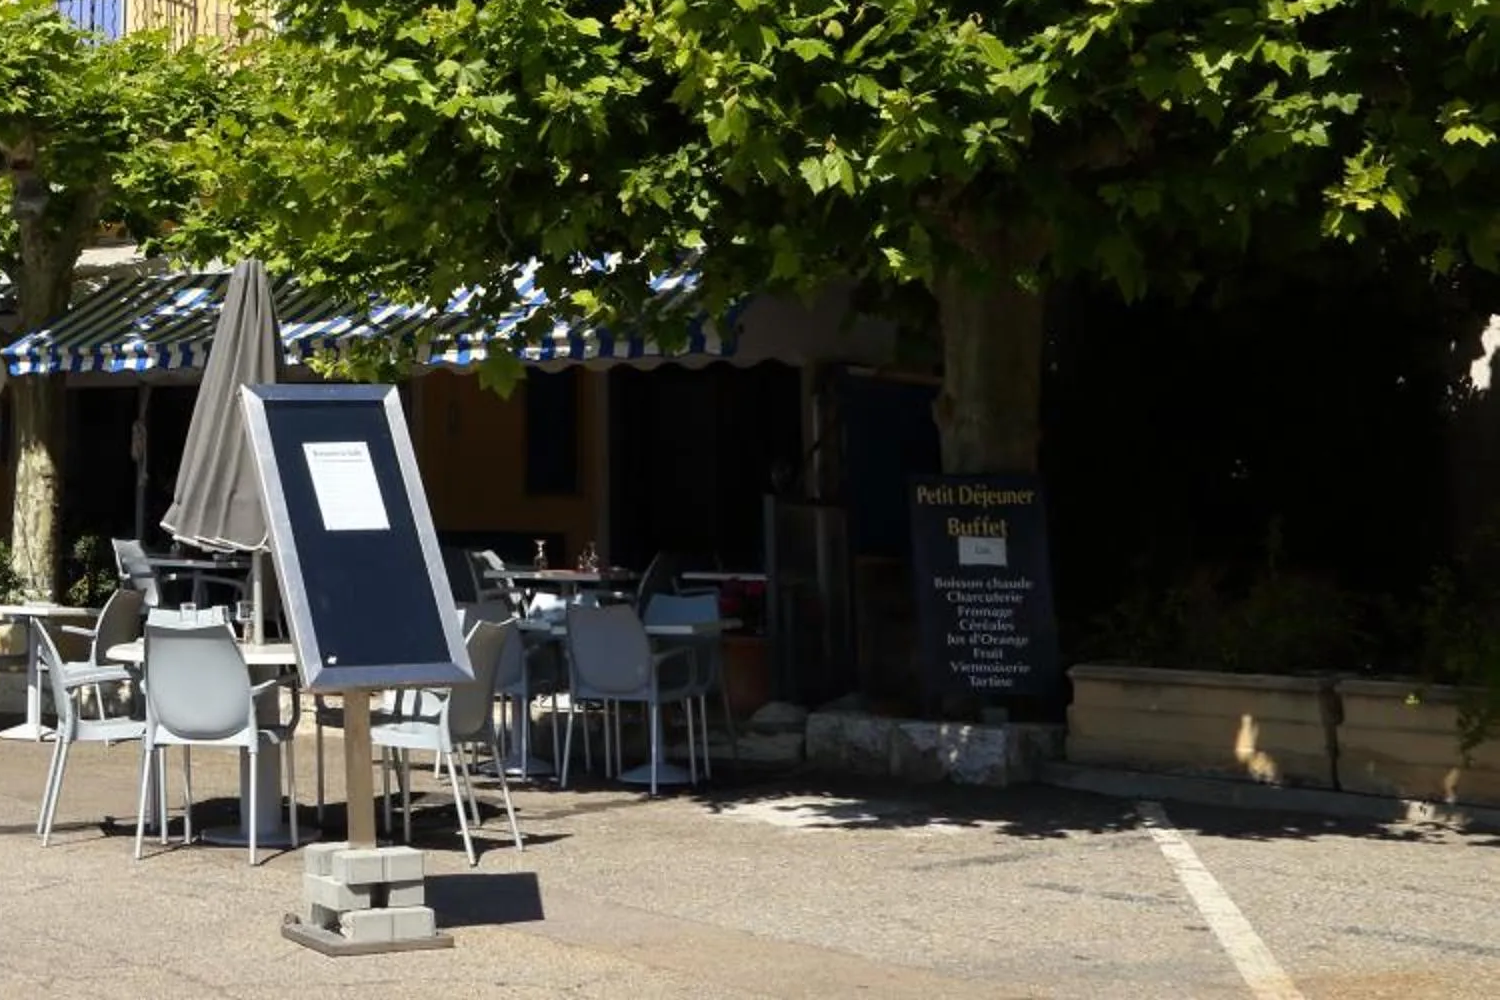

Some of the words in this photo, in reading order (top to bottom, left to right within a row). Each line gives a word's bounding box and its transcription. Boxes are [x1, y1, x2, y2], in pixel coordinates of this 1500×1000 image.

[917, 484, 954, 506] Petit
[958, 483, 1035, 508] Déjeuner
[947, 515, 1008, 538] Buffet
[933, 576, 983, 590] Boisson
[985, 576, 1034, 590] chaude
[946, 590, 1024, 603] Charcuterie
[957, 605, 1014, 618] Fromage
[959, 618, 1015, 632] Céréales
[969, 633, 1029, 648] d'Orange
[949, 661, 1032, 674] Viennoiserie
